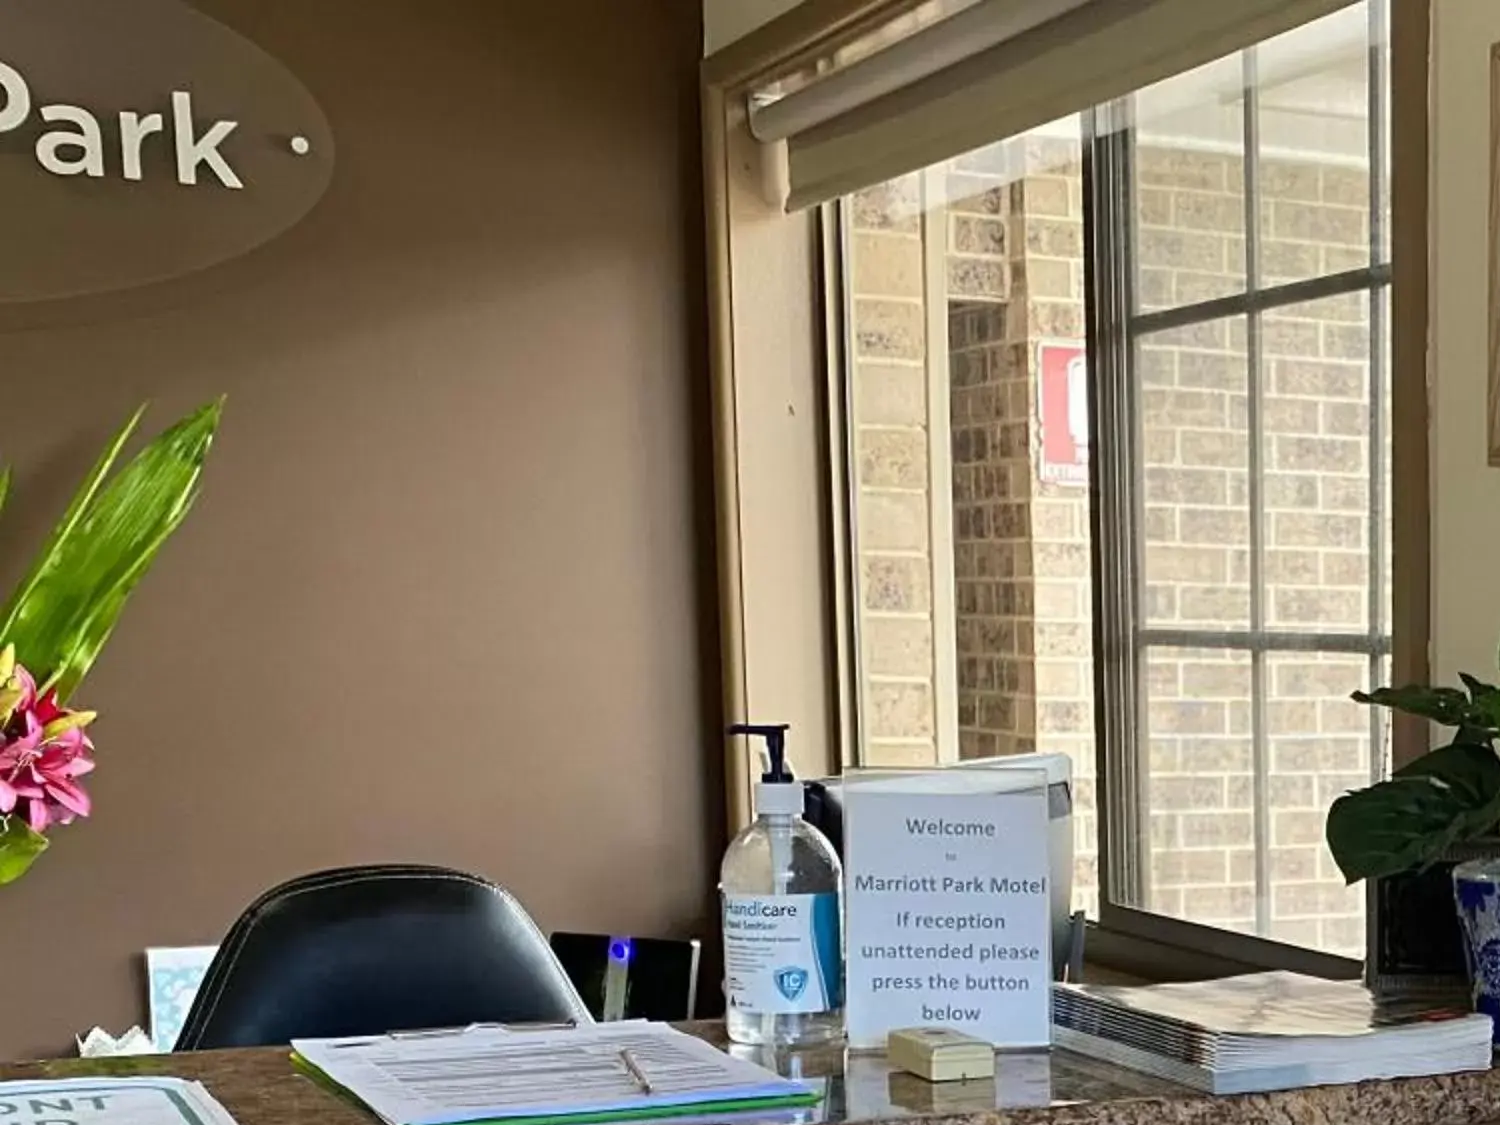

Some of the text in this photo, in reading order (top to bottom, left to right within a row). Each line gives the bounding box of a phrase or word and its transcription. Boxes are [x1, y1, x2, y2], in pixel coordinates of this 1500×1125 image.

[905, 818, 996, 838] Welcome
[854, 874, 1046, 895] Marriott Park Motel
[896, 911, 1006, 933] If reception
[861, 943, 1040, 964] unattended please
[872, 974, 1030, 993] press the button
[922, 1004, 982, 1022] below
